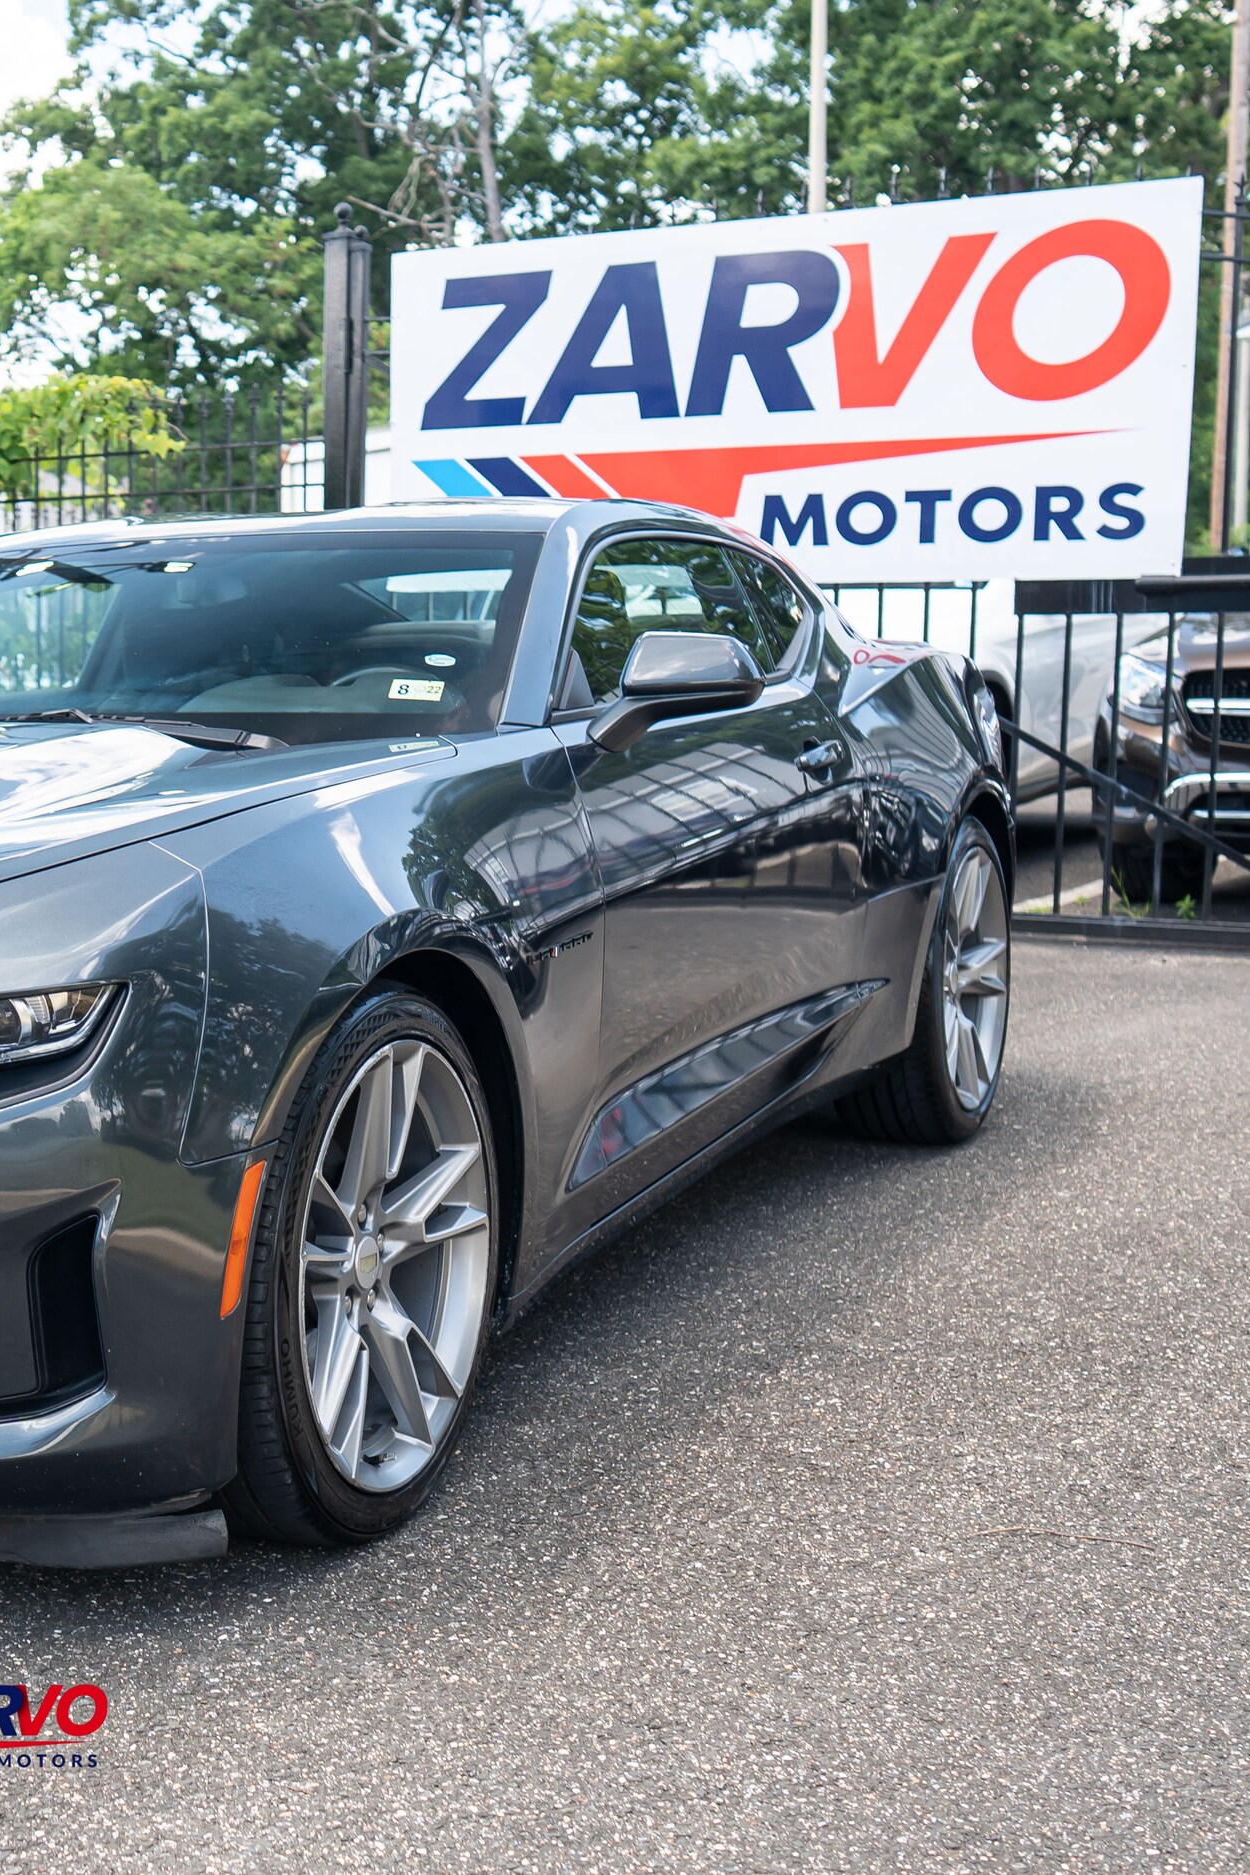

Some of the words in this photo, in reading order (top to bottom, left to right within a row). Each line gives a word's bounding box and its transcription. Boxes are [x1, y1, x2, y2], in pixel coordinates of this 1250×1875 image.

[420, 218, 1172, 431] ZARVO
[760, 483, 1146, 546] MOTORS
[397, 684, 409, 695] 8
[426, 685, 441, 694] 22
[281, 1338, 303, 1439] KUMHO
